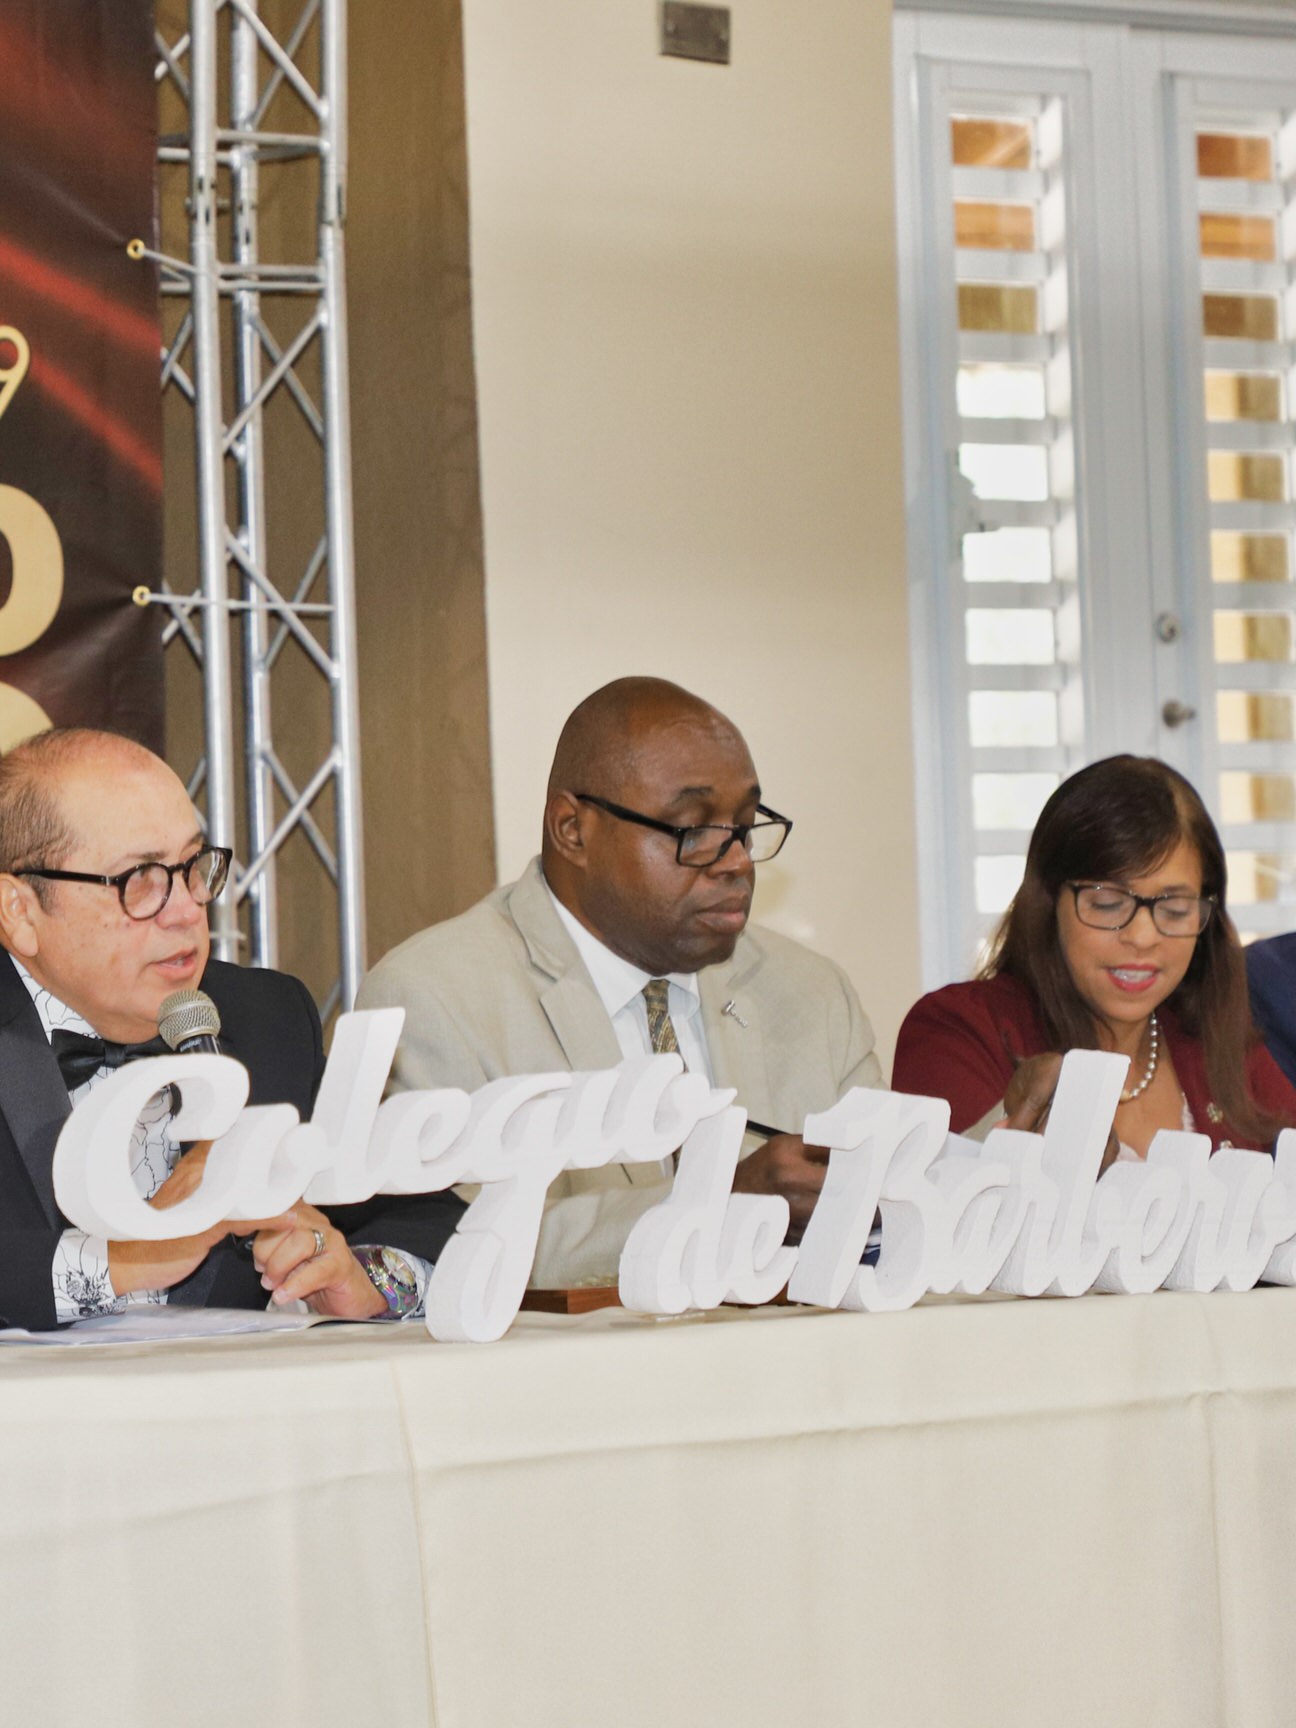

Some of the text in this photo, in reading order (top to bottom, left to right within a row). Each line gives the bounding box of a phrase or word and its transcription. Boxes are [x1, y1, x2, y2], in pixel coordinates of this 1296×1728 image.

[52, 1006, 738, 1343] Colegio
[619, 1106, 800, 1314] de
[787, 1048, 1296, 1312] Barbero
